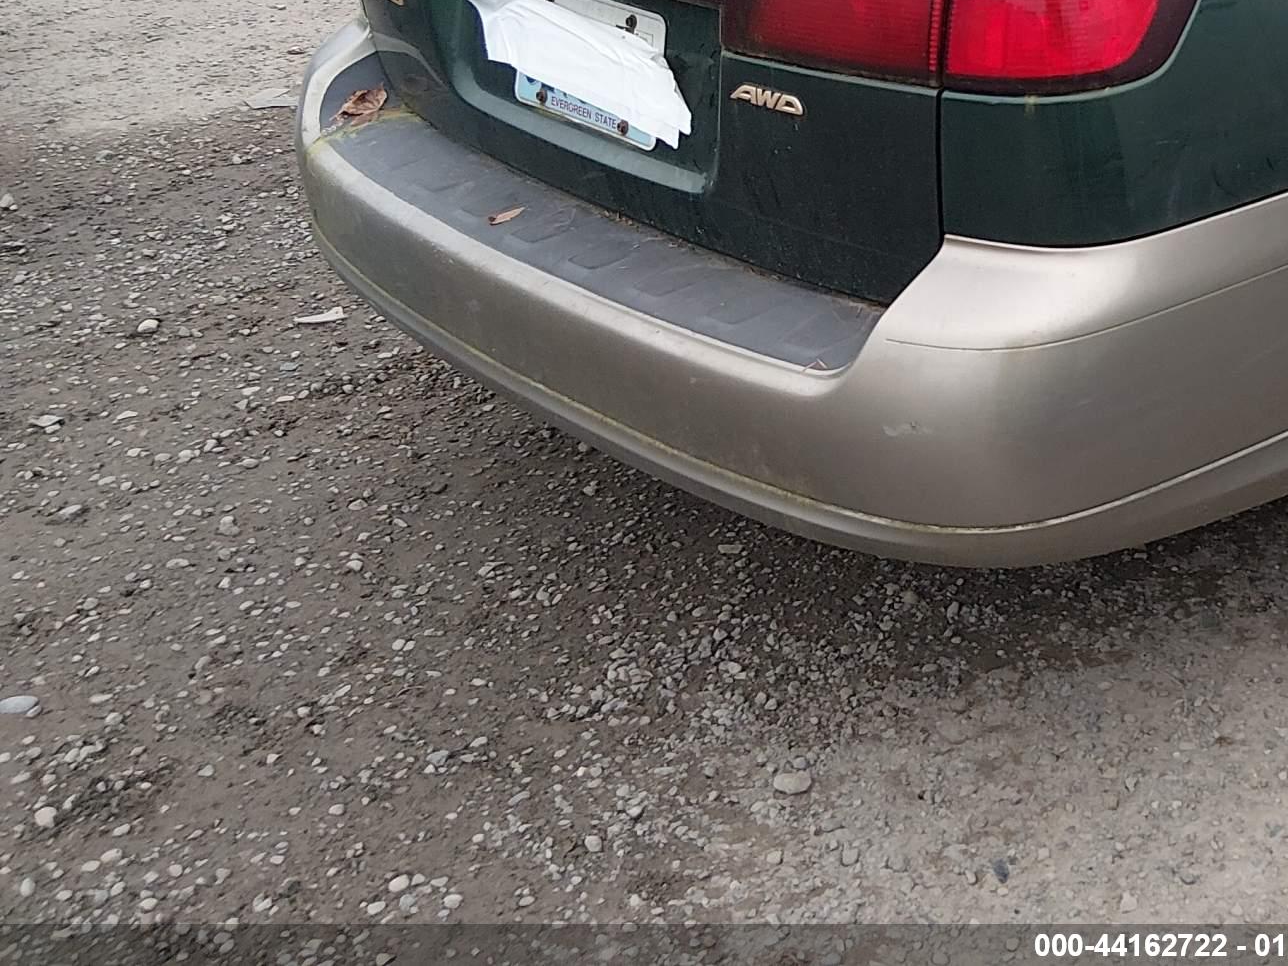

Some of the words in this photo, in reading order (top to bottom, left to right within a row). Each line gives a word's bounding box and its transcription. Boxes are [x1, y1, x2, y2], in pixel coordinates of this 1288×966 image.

[551, 96, 592, 120] EVERGREEN
[594, 112, 618, 130] STATE
[730, 83, 804, 116] AWD
